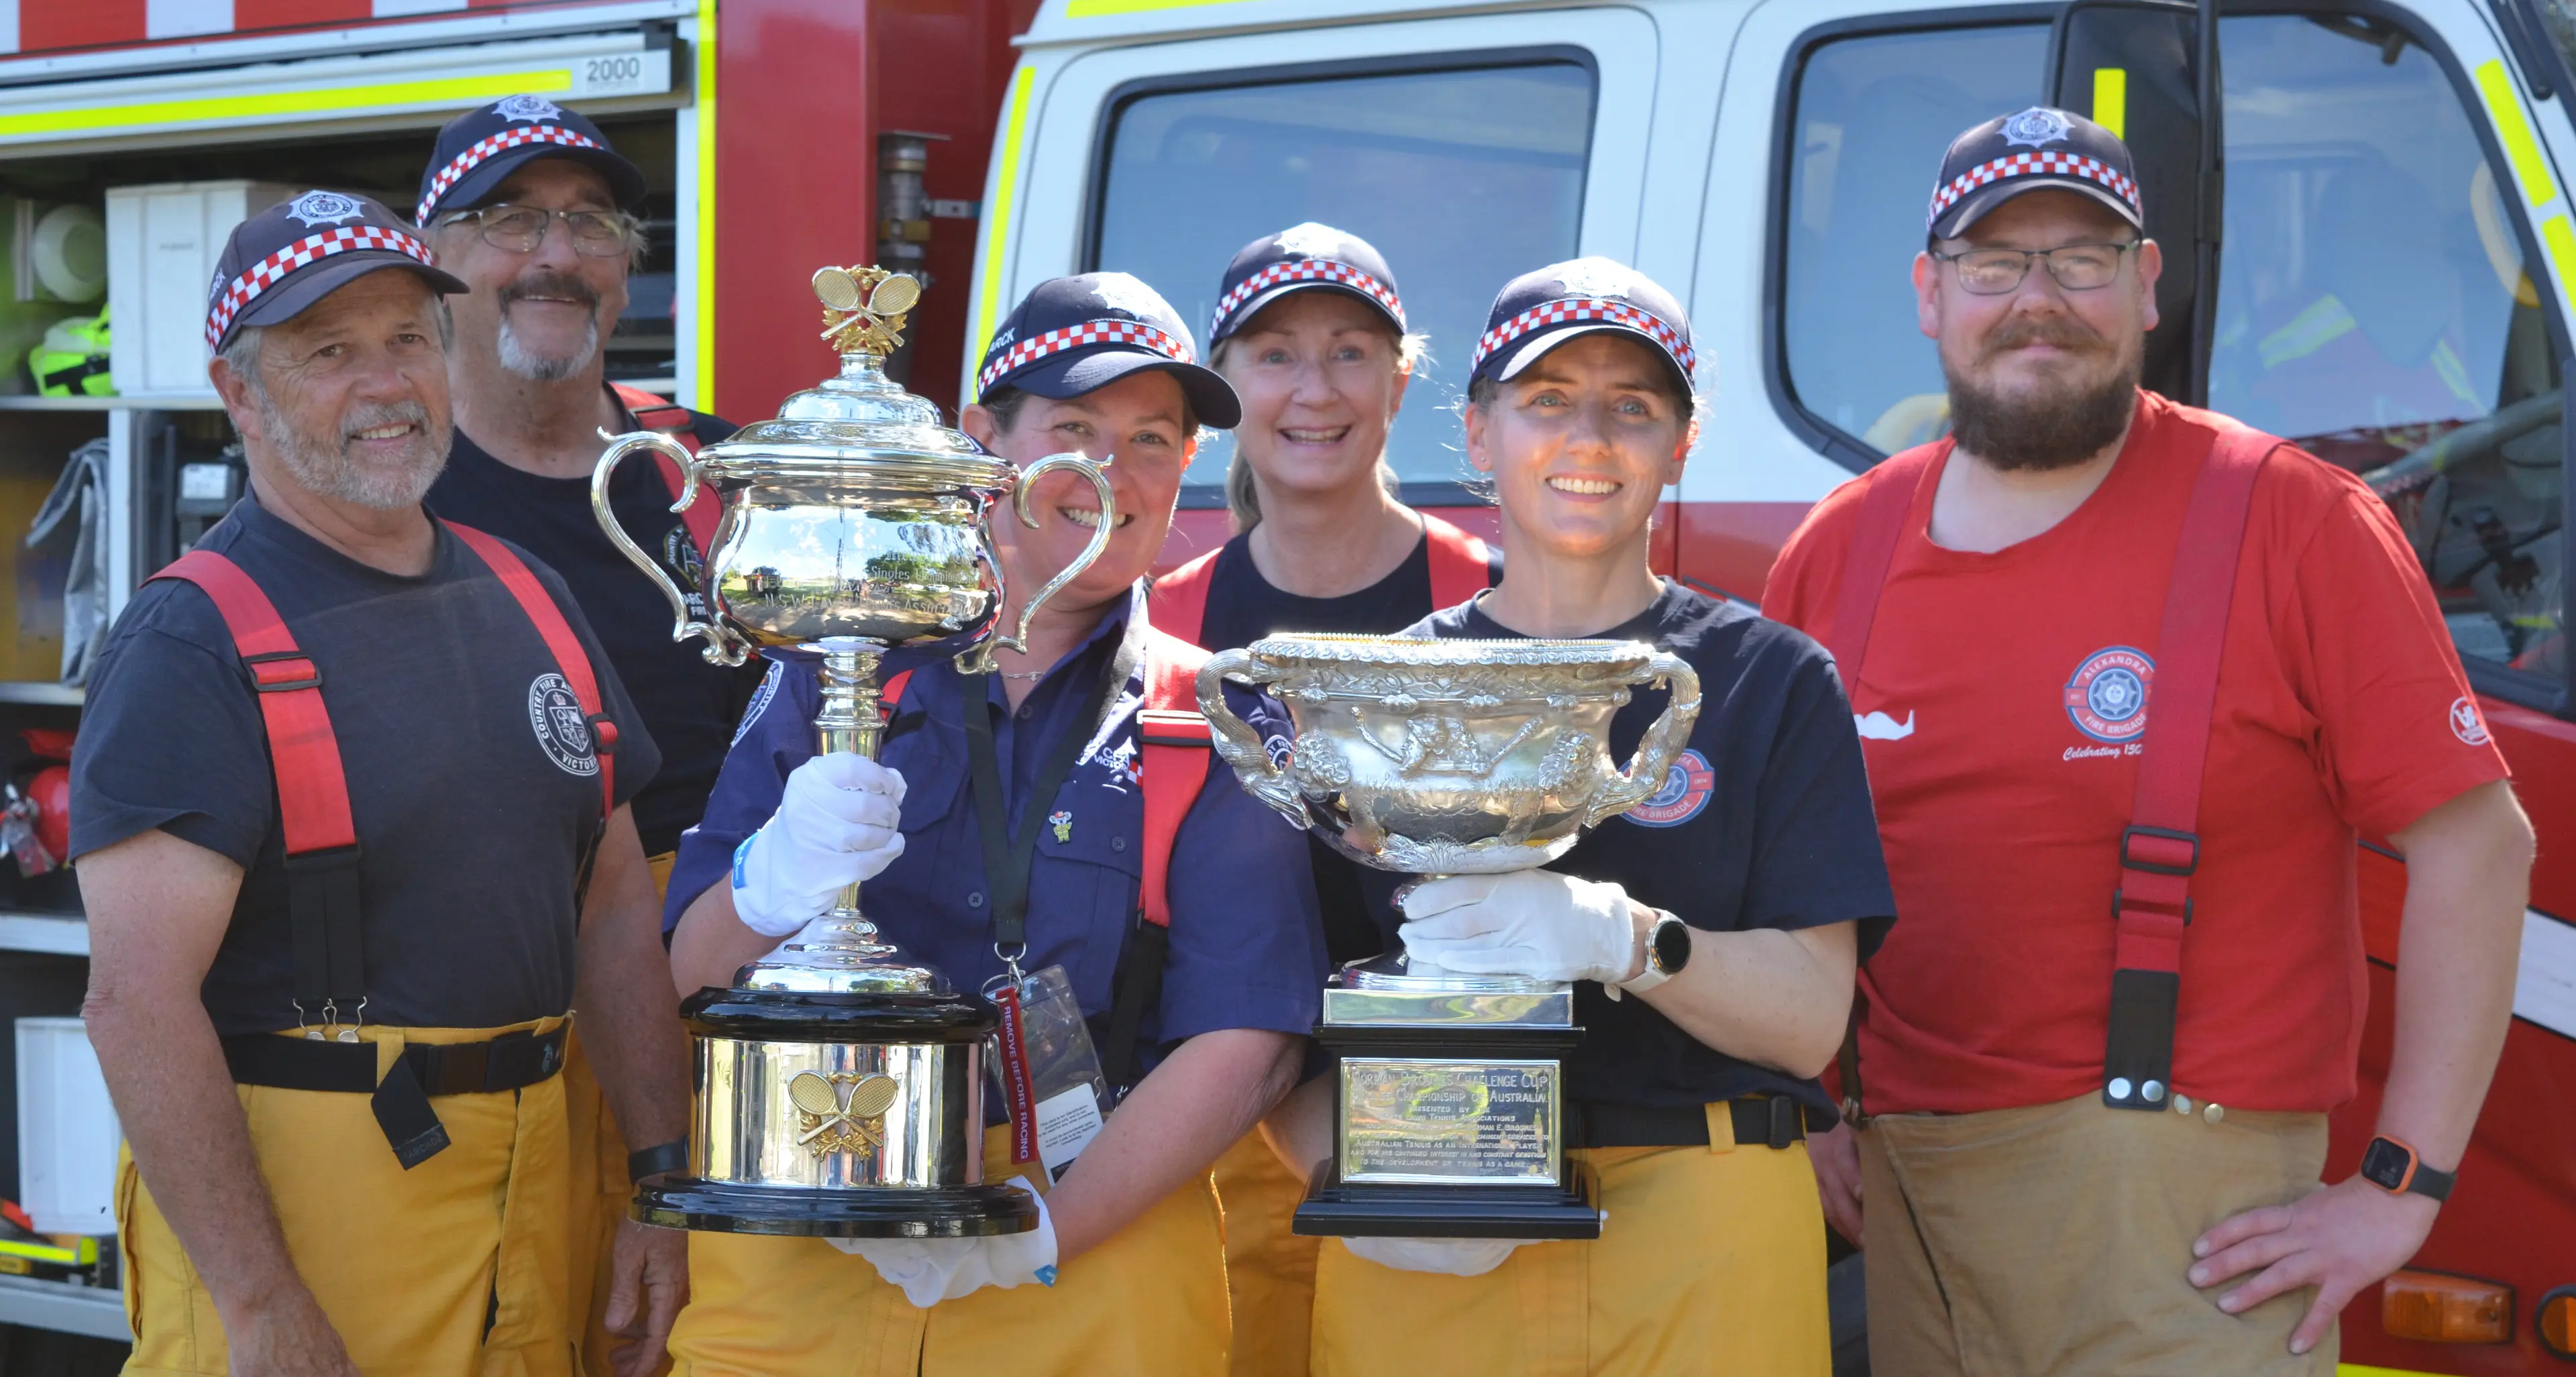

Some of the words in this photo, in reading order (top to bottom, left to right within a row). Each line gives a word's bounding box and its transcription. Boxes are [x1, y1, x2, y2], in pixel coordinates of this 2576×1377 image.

[587, 57, 641, 82] 2000
[871, 565, 910, 582] Singles
[2084, 656, 2147, 679] ALEXANDRA
[539, 679, 557, 692] FIRE
[534, 690, 549, 739] COUNTRY
[2085, 716, 2105, 732] FIRE
[2063, 746, 2121, 761] Celebrating
[1648, 800, 1692, 818] BRIGADE
[1004, 1006, 1017, 1058] REMOVE
[1011, 1061, 1027, 1110] BEFORE
[1019, 1113, 1028, 1160] RACING
[1457, 1073, 1517, 1087] CHALLENGE
[1521, 1075, 1548, 1088] CUP
[1397, 1089, 1465, 1102] CHAMPIONSHIP
[1429, 1113, 1456, 1121] TENNIS
[1356, 1140, 1402, 1148] AUSTRALIAN
